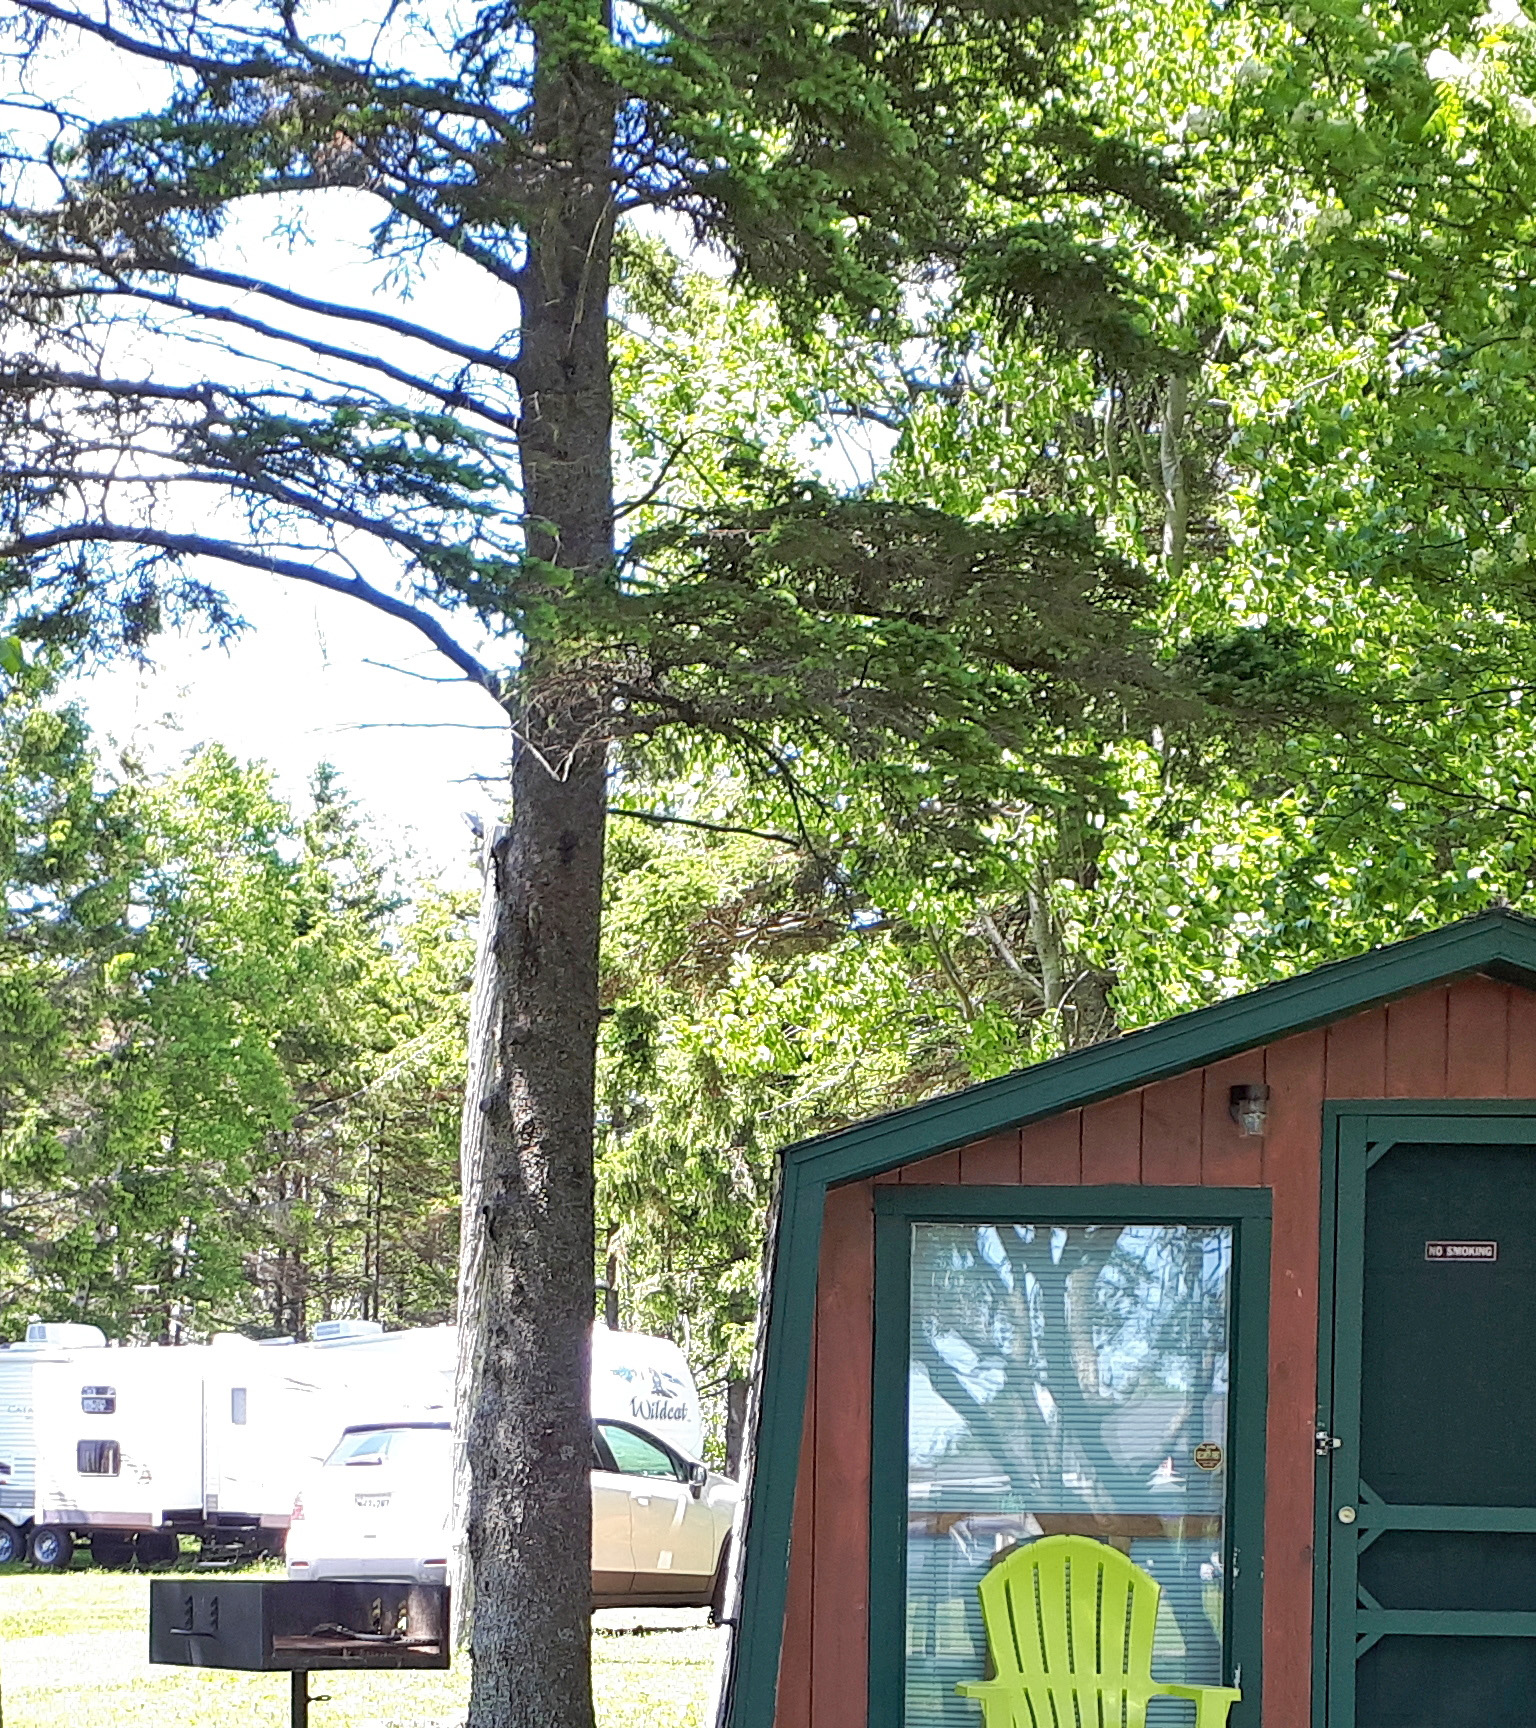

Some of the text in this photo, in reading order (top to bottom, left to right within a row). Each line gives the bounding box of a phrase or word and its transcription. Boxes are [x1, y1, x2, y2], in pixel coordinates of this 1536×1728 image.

[1428, 1245, 1493, 1257] NO SMOKING
[628, 1395, 688, 1421] Wildcat
